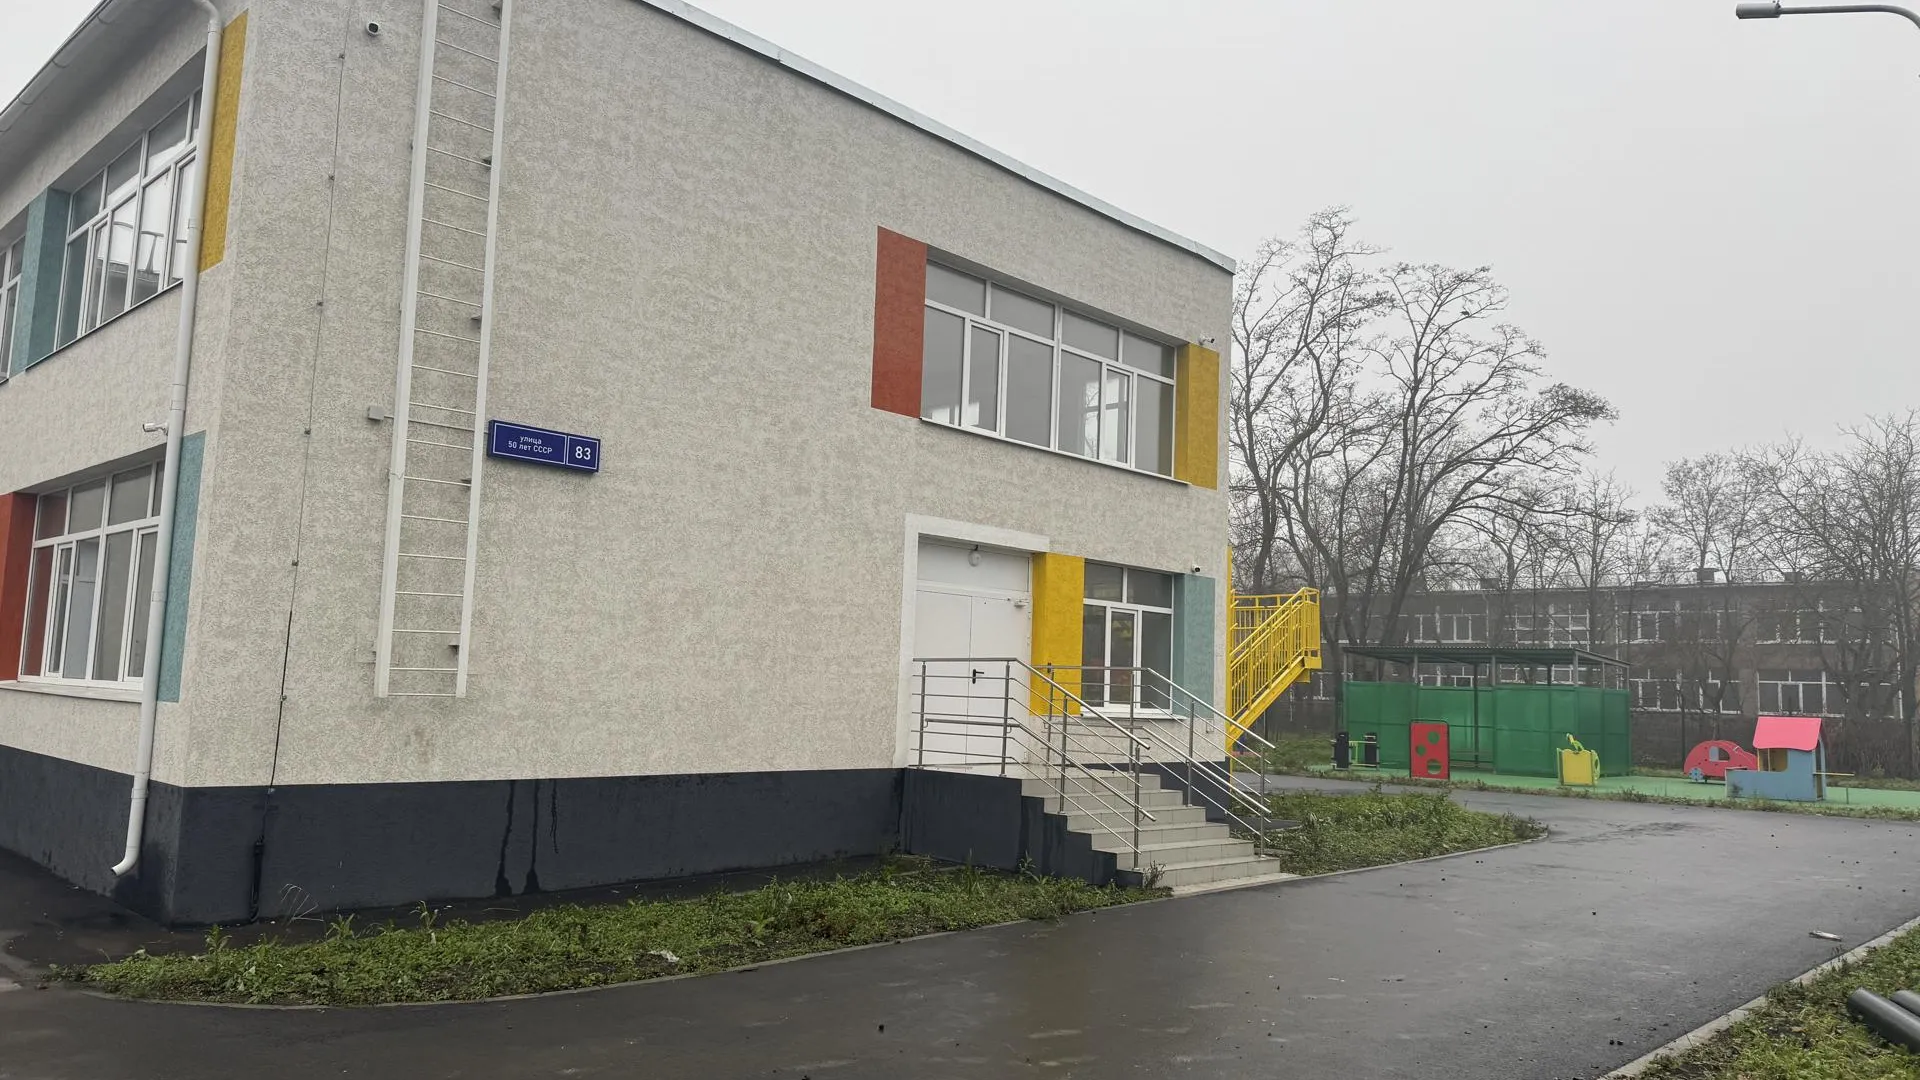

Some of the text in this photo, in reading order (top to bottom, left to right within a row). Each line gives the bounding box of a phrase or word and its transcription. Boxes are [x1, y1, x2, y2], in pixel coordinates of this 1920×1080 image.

[508, 440, 516, 448] 50
[533, 445, 552, 454] СССР
[520, 436, 542, 444] улица
[575, 446, 591, 460] 83
